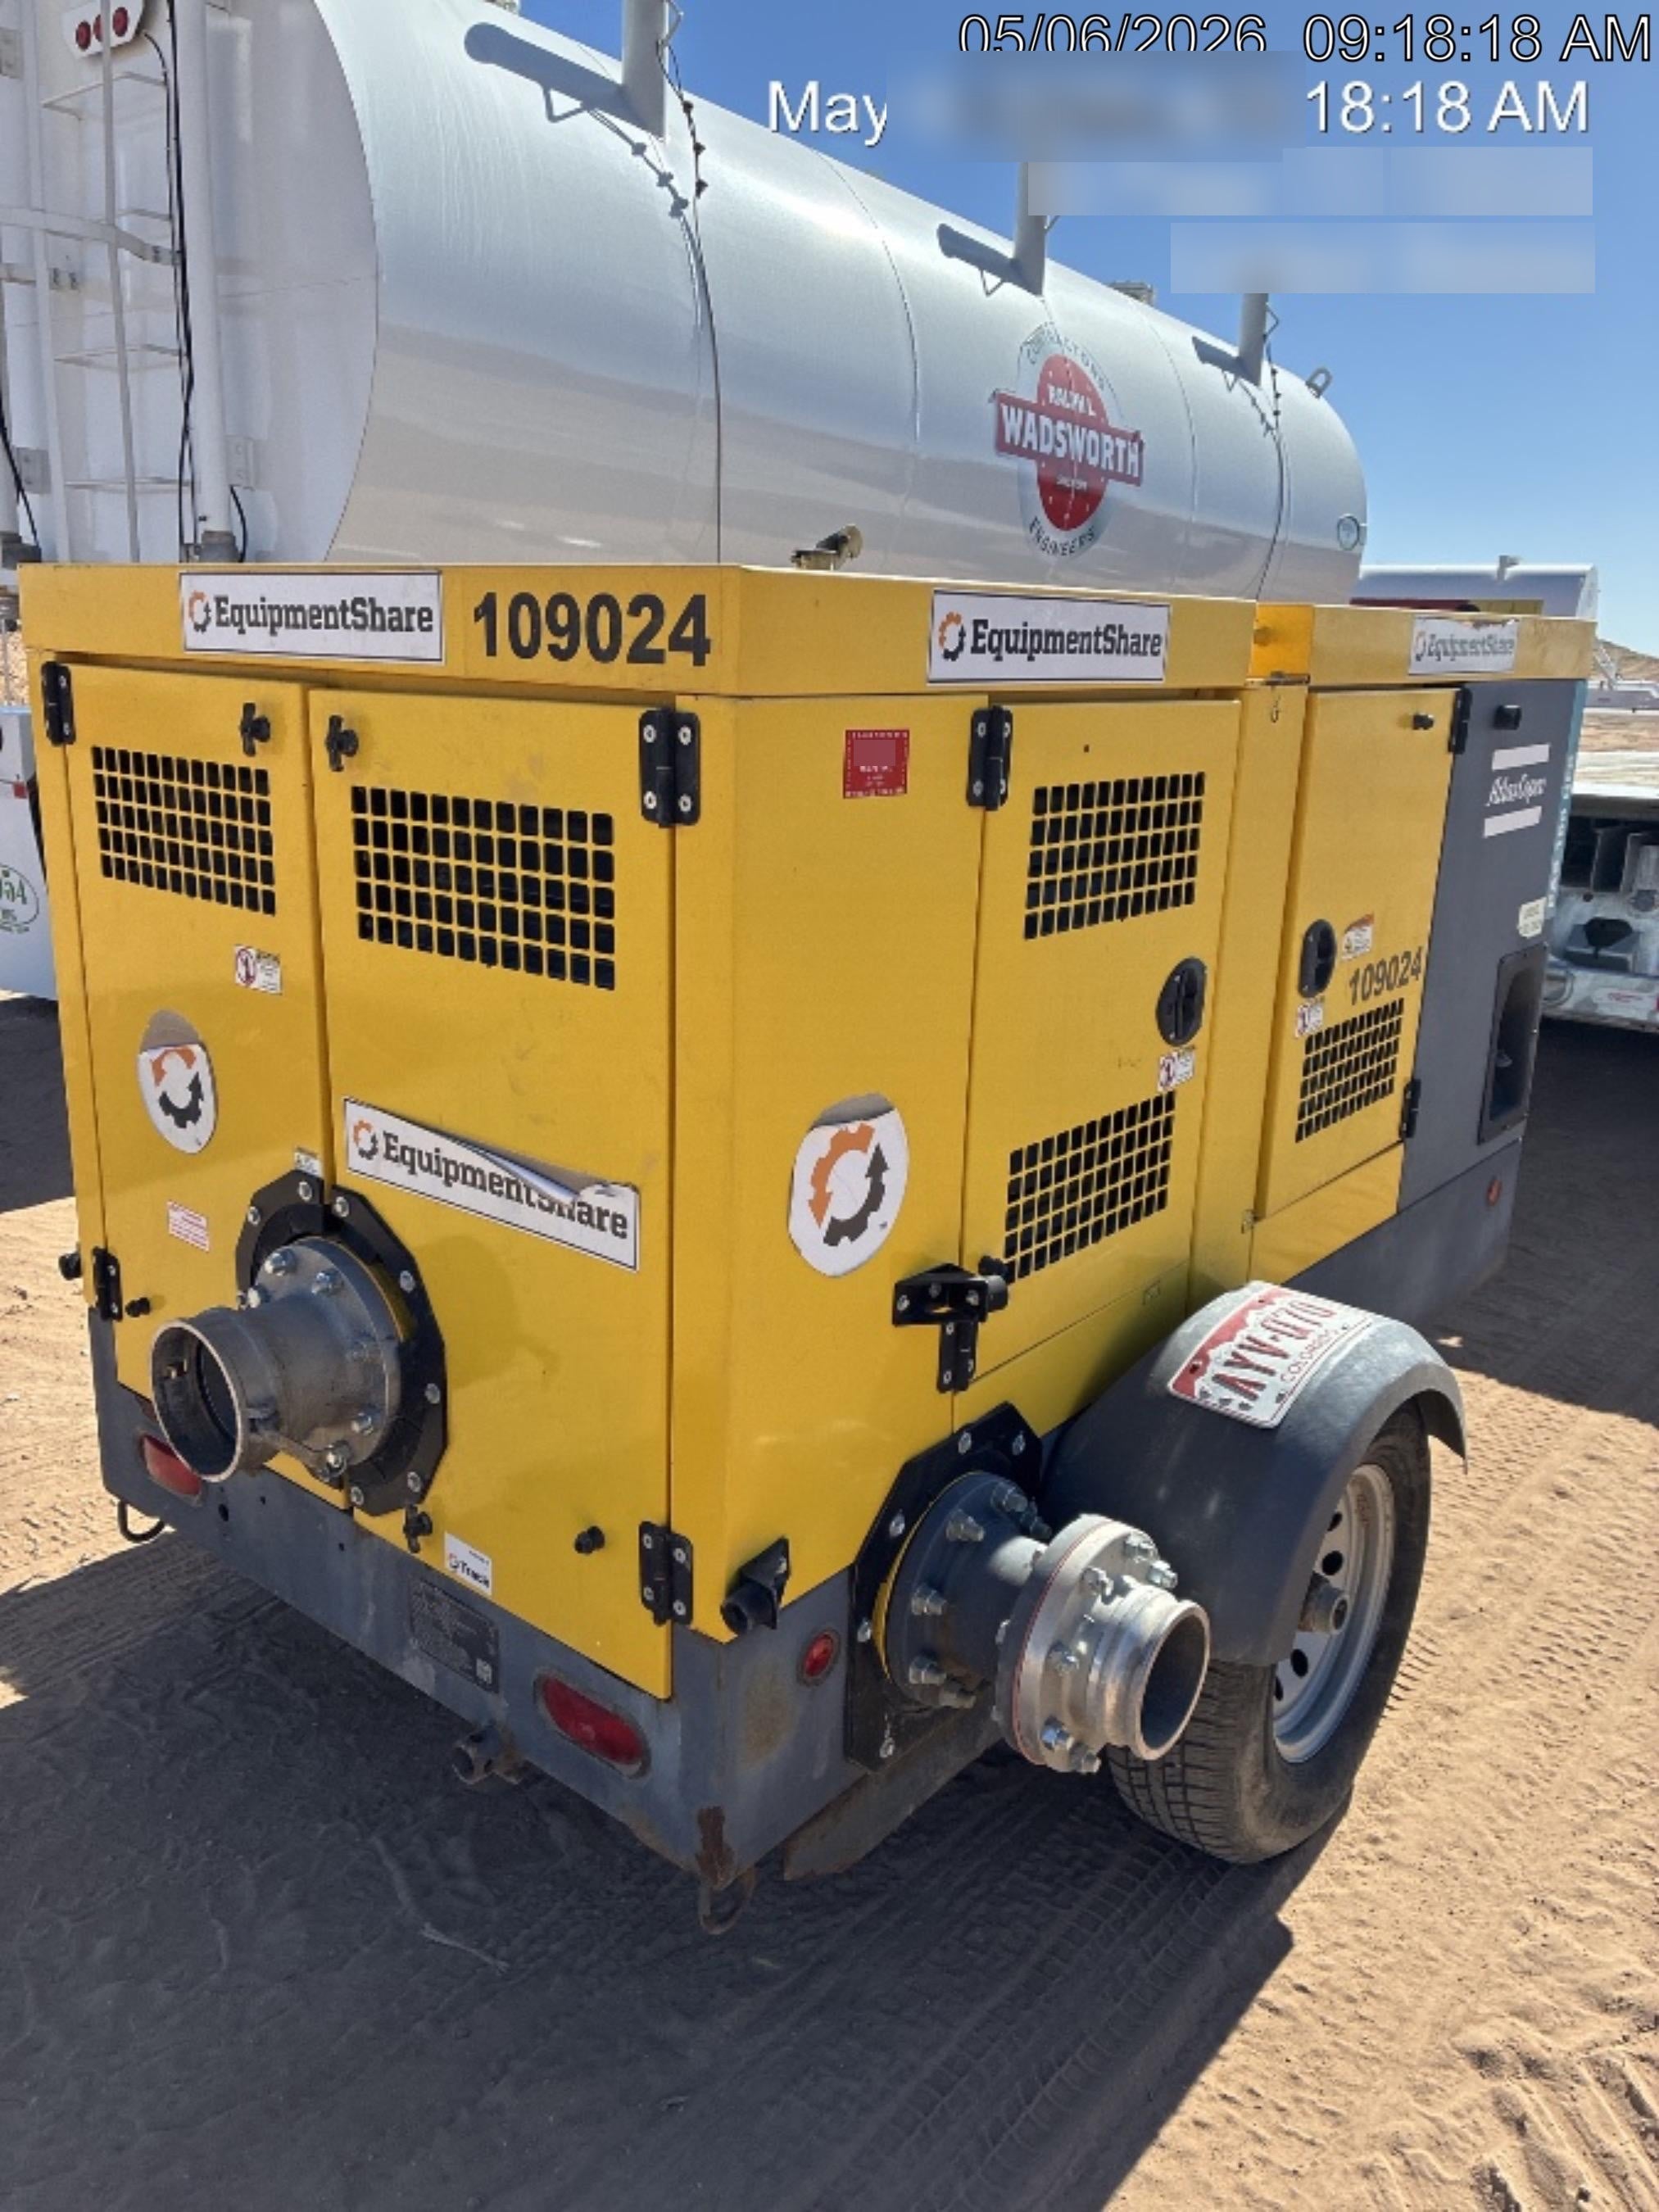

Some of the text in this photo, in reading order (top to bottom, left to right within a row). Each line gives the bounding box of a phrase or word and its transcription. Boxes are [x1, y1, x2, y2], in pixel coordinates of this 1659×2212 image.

[1001, 404, 1140, 478] WADSWORTH
[215, 595, 434, 637] EquipmentShare
[474, 591, 711, 667] 109024
[970, 619, 1163, 662] EquipmentShare
[1349, 946, 1422, 1006] 109024
